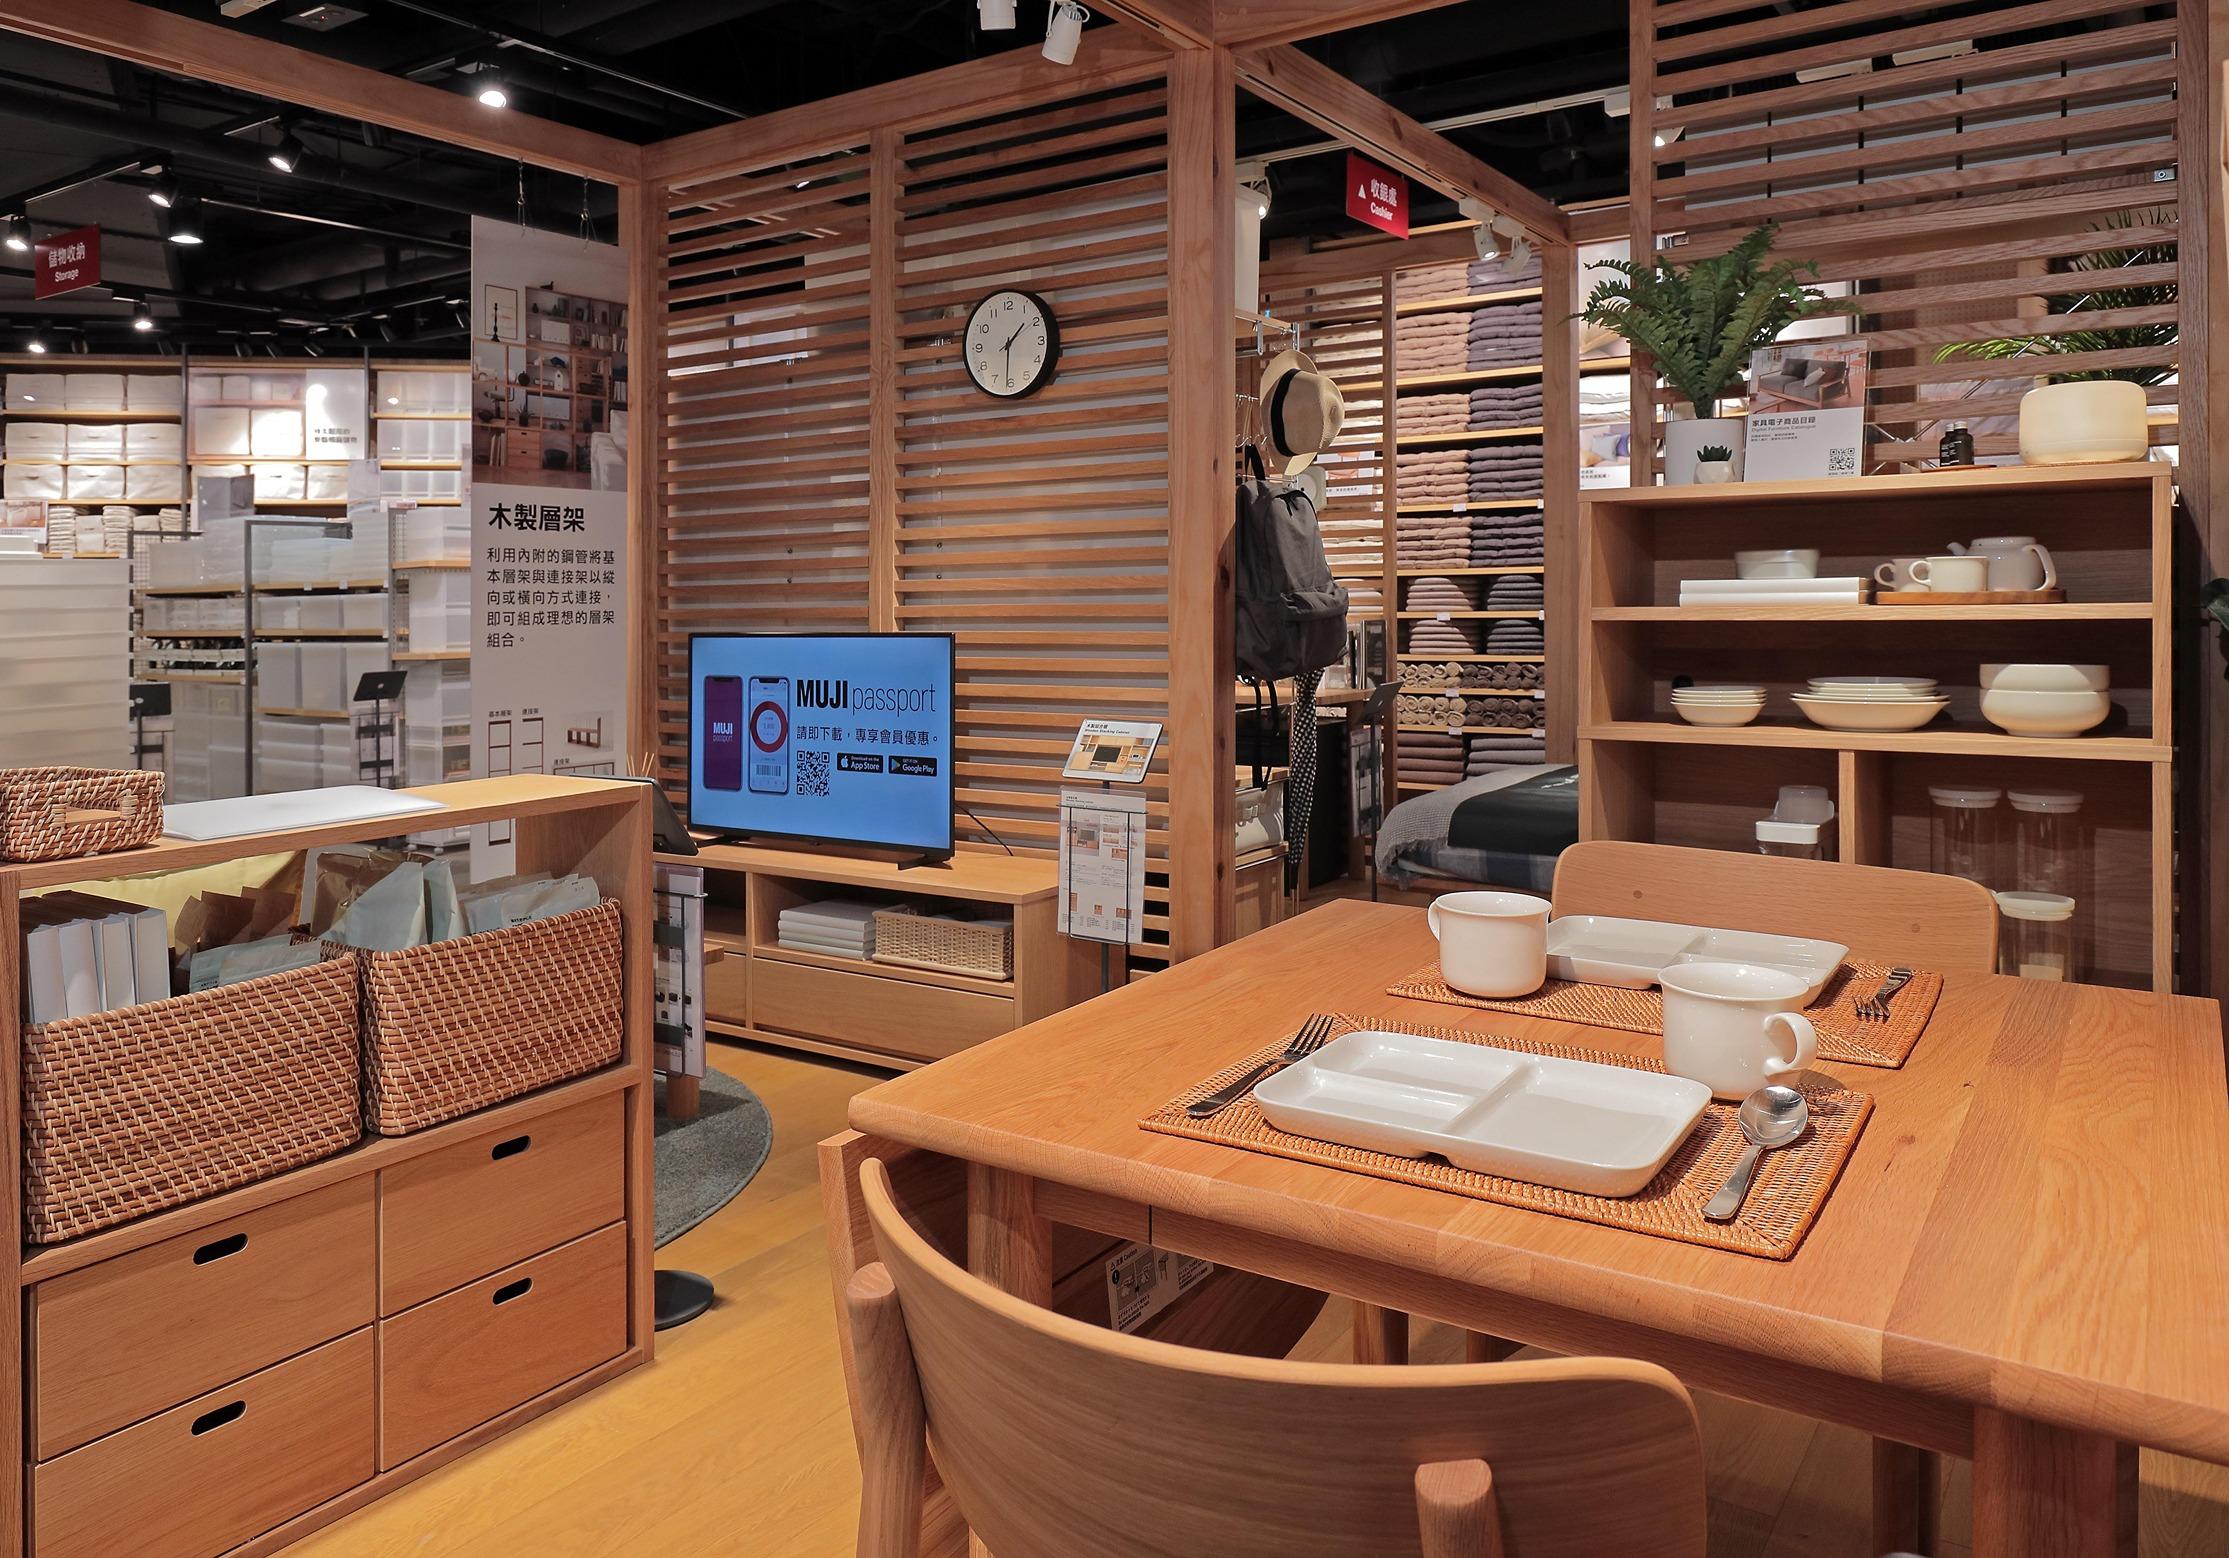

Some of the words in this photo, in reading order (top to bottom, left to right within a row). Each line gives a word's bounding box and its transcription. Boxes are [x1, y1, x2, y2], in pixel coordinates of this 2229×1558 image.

[1370, 201, 1393, 221] Cashier
[54, 268, 79, 282] Storage
[1003, 301, 1014, 311] 12
[990, 309, 998, 319] 11
[1032, 317, 1040, 327] 2
[979, 324, 990, 334] 10
[1037, 336, 1045, 346] 3
[975, 344, 983, 353] 9
[1033, 355, 1041, 364] 4
[980, 361, 988, 371] 8
[991, 375, 999, 384] 7
[1023, 371, 1030, 381] 5
[488, 502, 585, 533] 木製層架
[486, 547, 615, 565] 利用內附的鋼管將基
[486, 568, 615, 585] 本層架與連接架以縱
[487, 610, 615, 627] 即可組成理想的層架
[486, 632, 525, 648] 組合。
[796, 679, 848, 709] MUJI
[852, 683, 936, 718] passport
[713, 722, 733, 735] MUJI
[850, 761, 863, 770] App
[864, 761, 880, 770] Store
[902, 763, 922, 773] Google
[922, 764, 935, 774] Play
